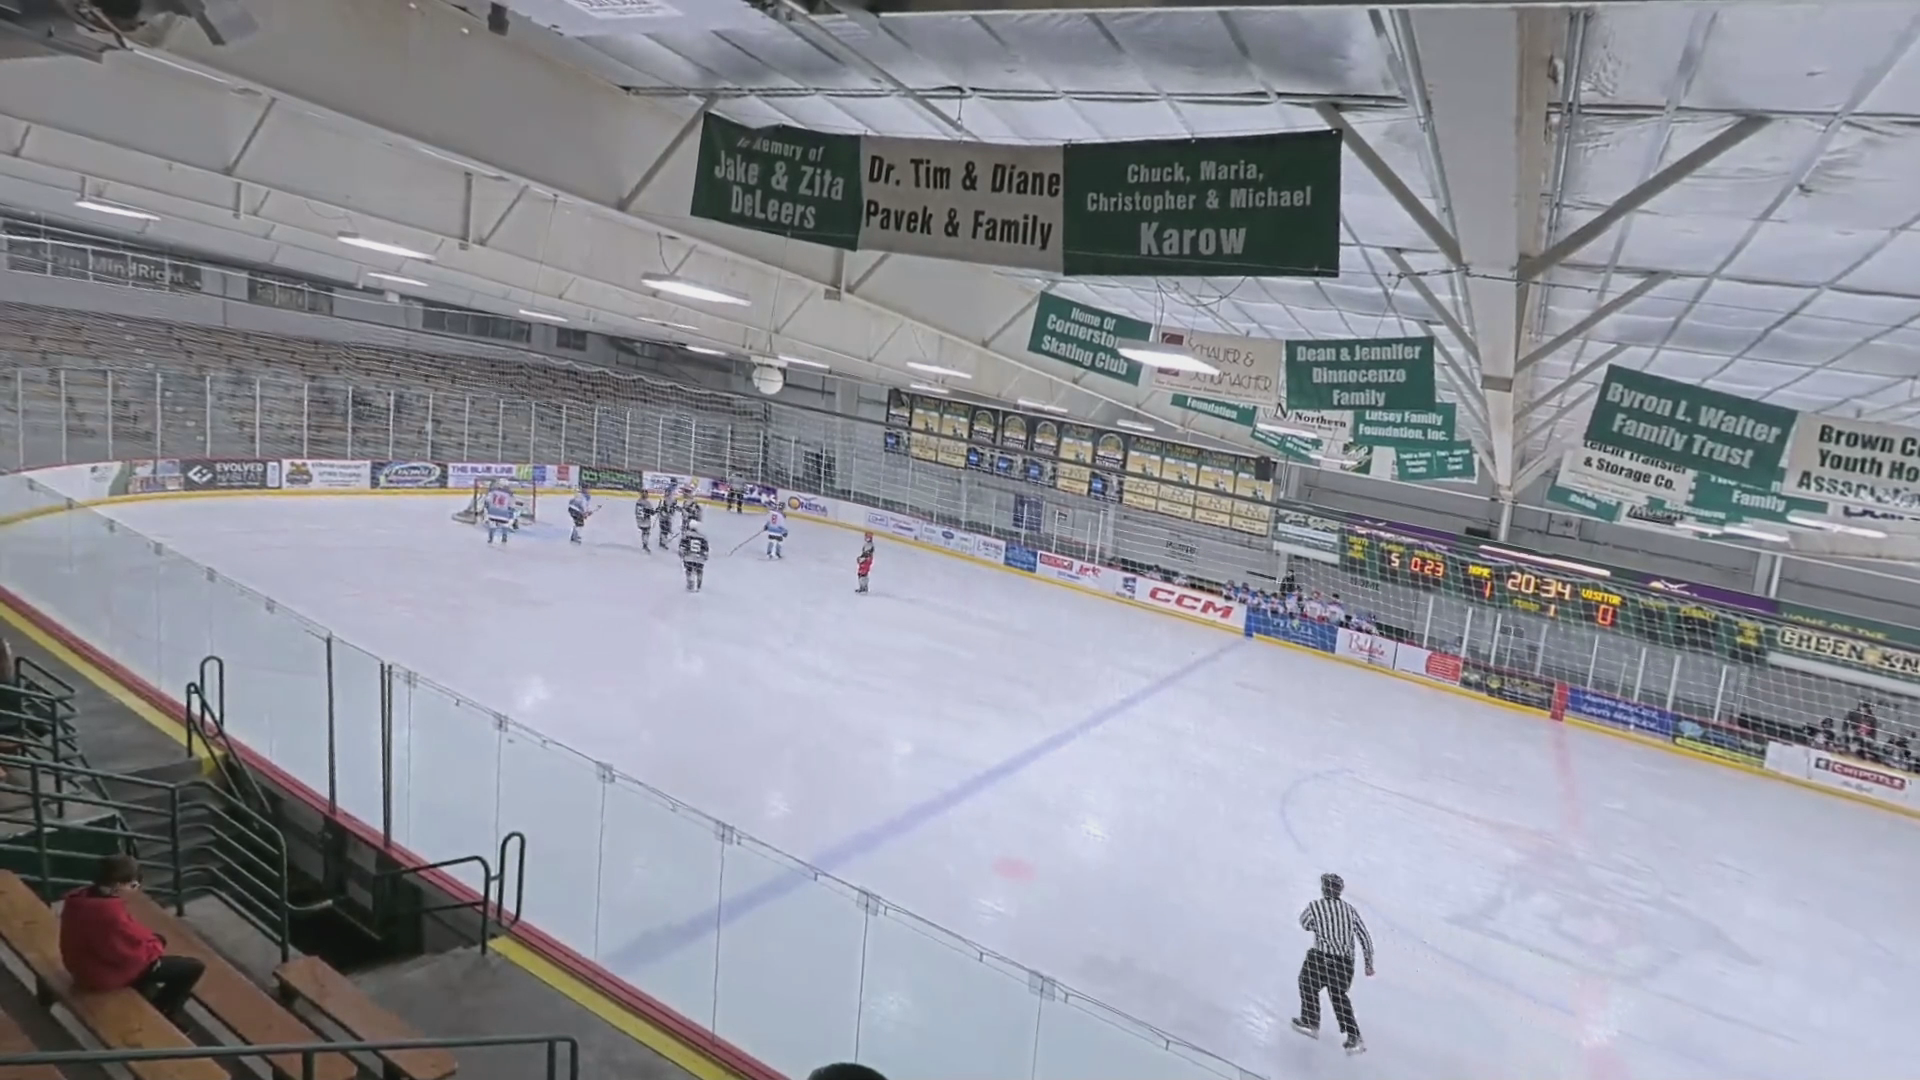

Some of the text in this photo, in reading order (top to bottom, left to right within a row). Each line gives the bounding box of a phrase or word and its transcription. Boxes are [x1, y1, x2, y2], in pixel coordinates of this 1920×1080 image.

[753, 138, 802, 161] Memory
[809, 146, 825, 162] of
[714, 151, 844, 201] Jake & Zita
[868, 155, 1061, 198] Dr. Tim & Diane
[1127, 160, 1264, 184] Chuck, Maria,
[731, 186, 816, 229] DeLeers
[1087, 186, 1312, 213] Christopher & Michael
[865, 200, 1053, 251] Pavek & Family
[1140, 222, 1247, 256] Karow
[1071, 307, 1117, 331] Home Of
[1047, 314, 1121, 349] Cornersto
[1041, 335, 1129, 376] Skating Club
[1297, 343, 1422, 362] Dean & Jennifer
[1312, 367, 1407, 384] Dinnocenzo
[1186, 397, 1238, 419] Foundation
[1333, 389, 1387, 407] Family
[1294, 411, 1348, 429] Northern
[1404, 410, 1445, 427] Family
[1606, 382, 1783, 444] Byron L. Walter
[1427, 427, 1450, 441] Inc.
[1612, 413, 1756, 470] Family Trust
[1818, 424, 1920, 459] Brown C
[216, 462, 264, 473] EVOLVED
[451, 465, 468, 475] THE
[470, 465, 495, 476] BLUE
[497, 466, 515, 476] LINE
[1583, 456, 1677, 492] & Storage Co.
[1818, 448, 1884, 478] Youth
[1731, 490, 1788, 513] Family
[1410, 556, 1445, 578] 0:23
[1468, 563, 1492, 578] HOME
[1507, 571, 1572, 600] 20:34
[1581, 588, 1622, 606] VISITOR
[1149, 585, 1235, 619] CCM
[1597, 604, 1614, 625] 0
[1832, 763, 1905, 790] CHIPOTLE
